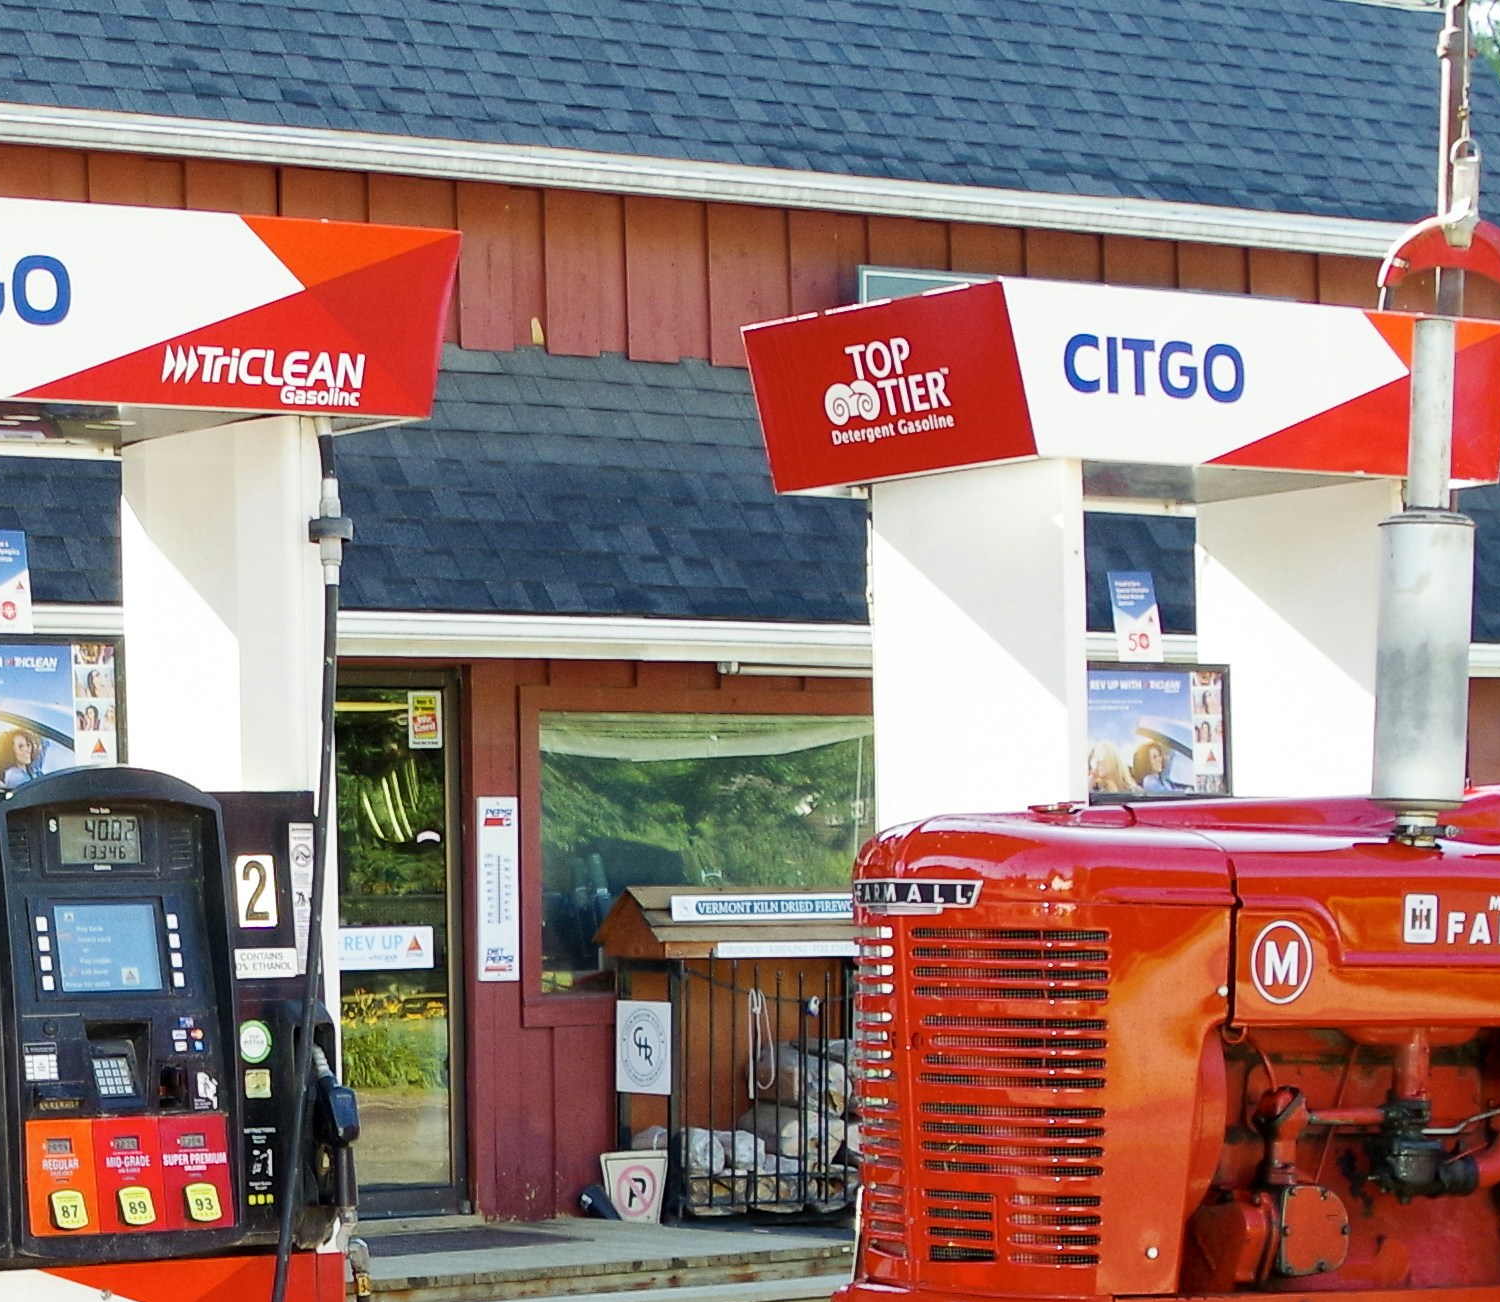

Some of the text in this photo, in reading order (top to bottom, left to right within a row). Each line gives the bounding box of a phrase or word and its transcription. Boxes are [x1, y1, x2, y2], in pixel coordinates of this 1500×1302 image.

[845, 337, 910, 380] TOP
[197, 345, 366, 389] TriCLEAN
[1063, 333, 1245, 403] CITGO
[280, 386, 361, 407] Gasoline
[831, 413, 955, 445] Detergent Gasoline
[1090, 680, 1107, 690] REV
[1108, 680, 1120, 690] UP
[1120, 680, 1142, 690] WITH
[485, 809, 512, 817] PEPSI
[49, 819, 57, 832] $
[242, 860, 270, 921] 2
[698, 900, 853, 914] VERMONT KILN DRIED FIREWO
[344, 935, 403, 951] REV UP
[240, 952, 284, 961] CONTAINS
[1264, 941, 1298, 985] M
[253, 962, 292, 971] ETHANOL
[42, 1158, 79, 1170] REGULAR
[106, 1156, 150, 1168] MID-GRADE
[162, 1152, 227, 1166] SUPER PREMIUM
[628, 1178, 646, 1208] P
[129, 1201, 148, 1215] 89
[195, 1197, 214, 1211] 93
[61, 1204, 79, 1219] 87
